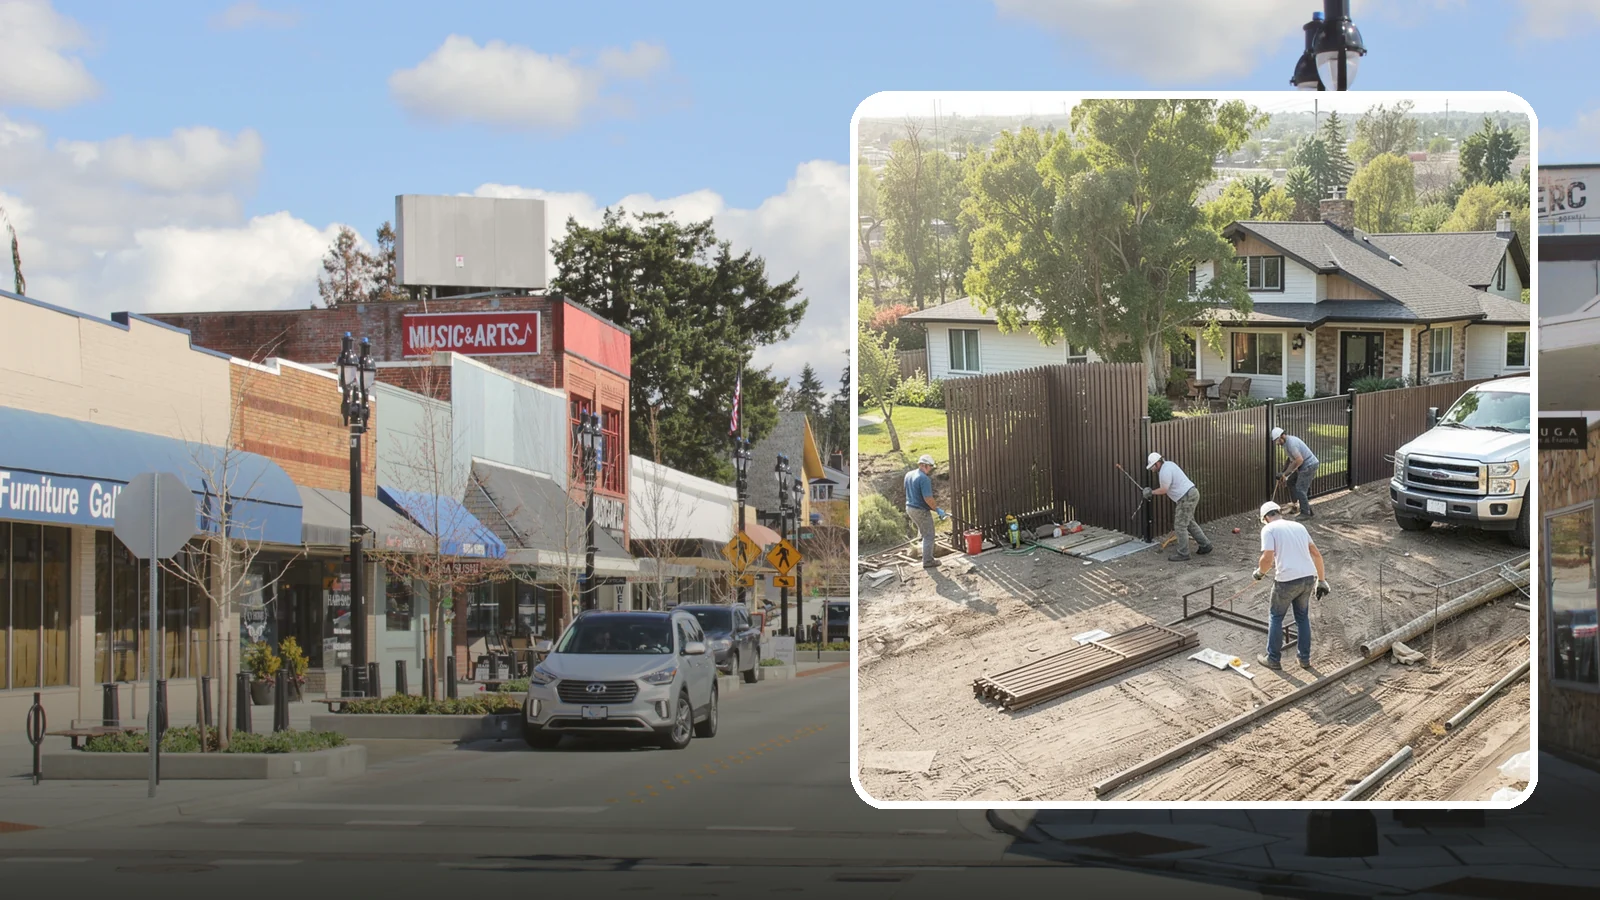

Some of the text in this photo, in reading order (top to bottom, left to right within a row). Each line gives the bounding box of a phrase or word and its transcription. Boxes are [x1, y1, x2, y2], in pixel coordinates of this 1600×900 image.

[408, 323, 519, 348] MUSIC&ARTS
[1540, 428, 1577, 436] UGA
[0, 471, 79, 515] Furniture
